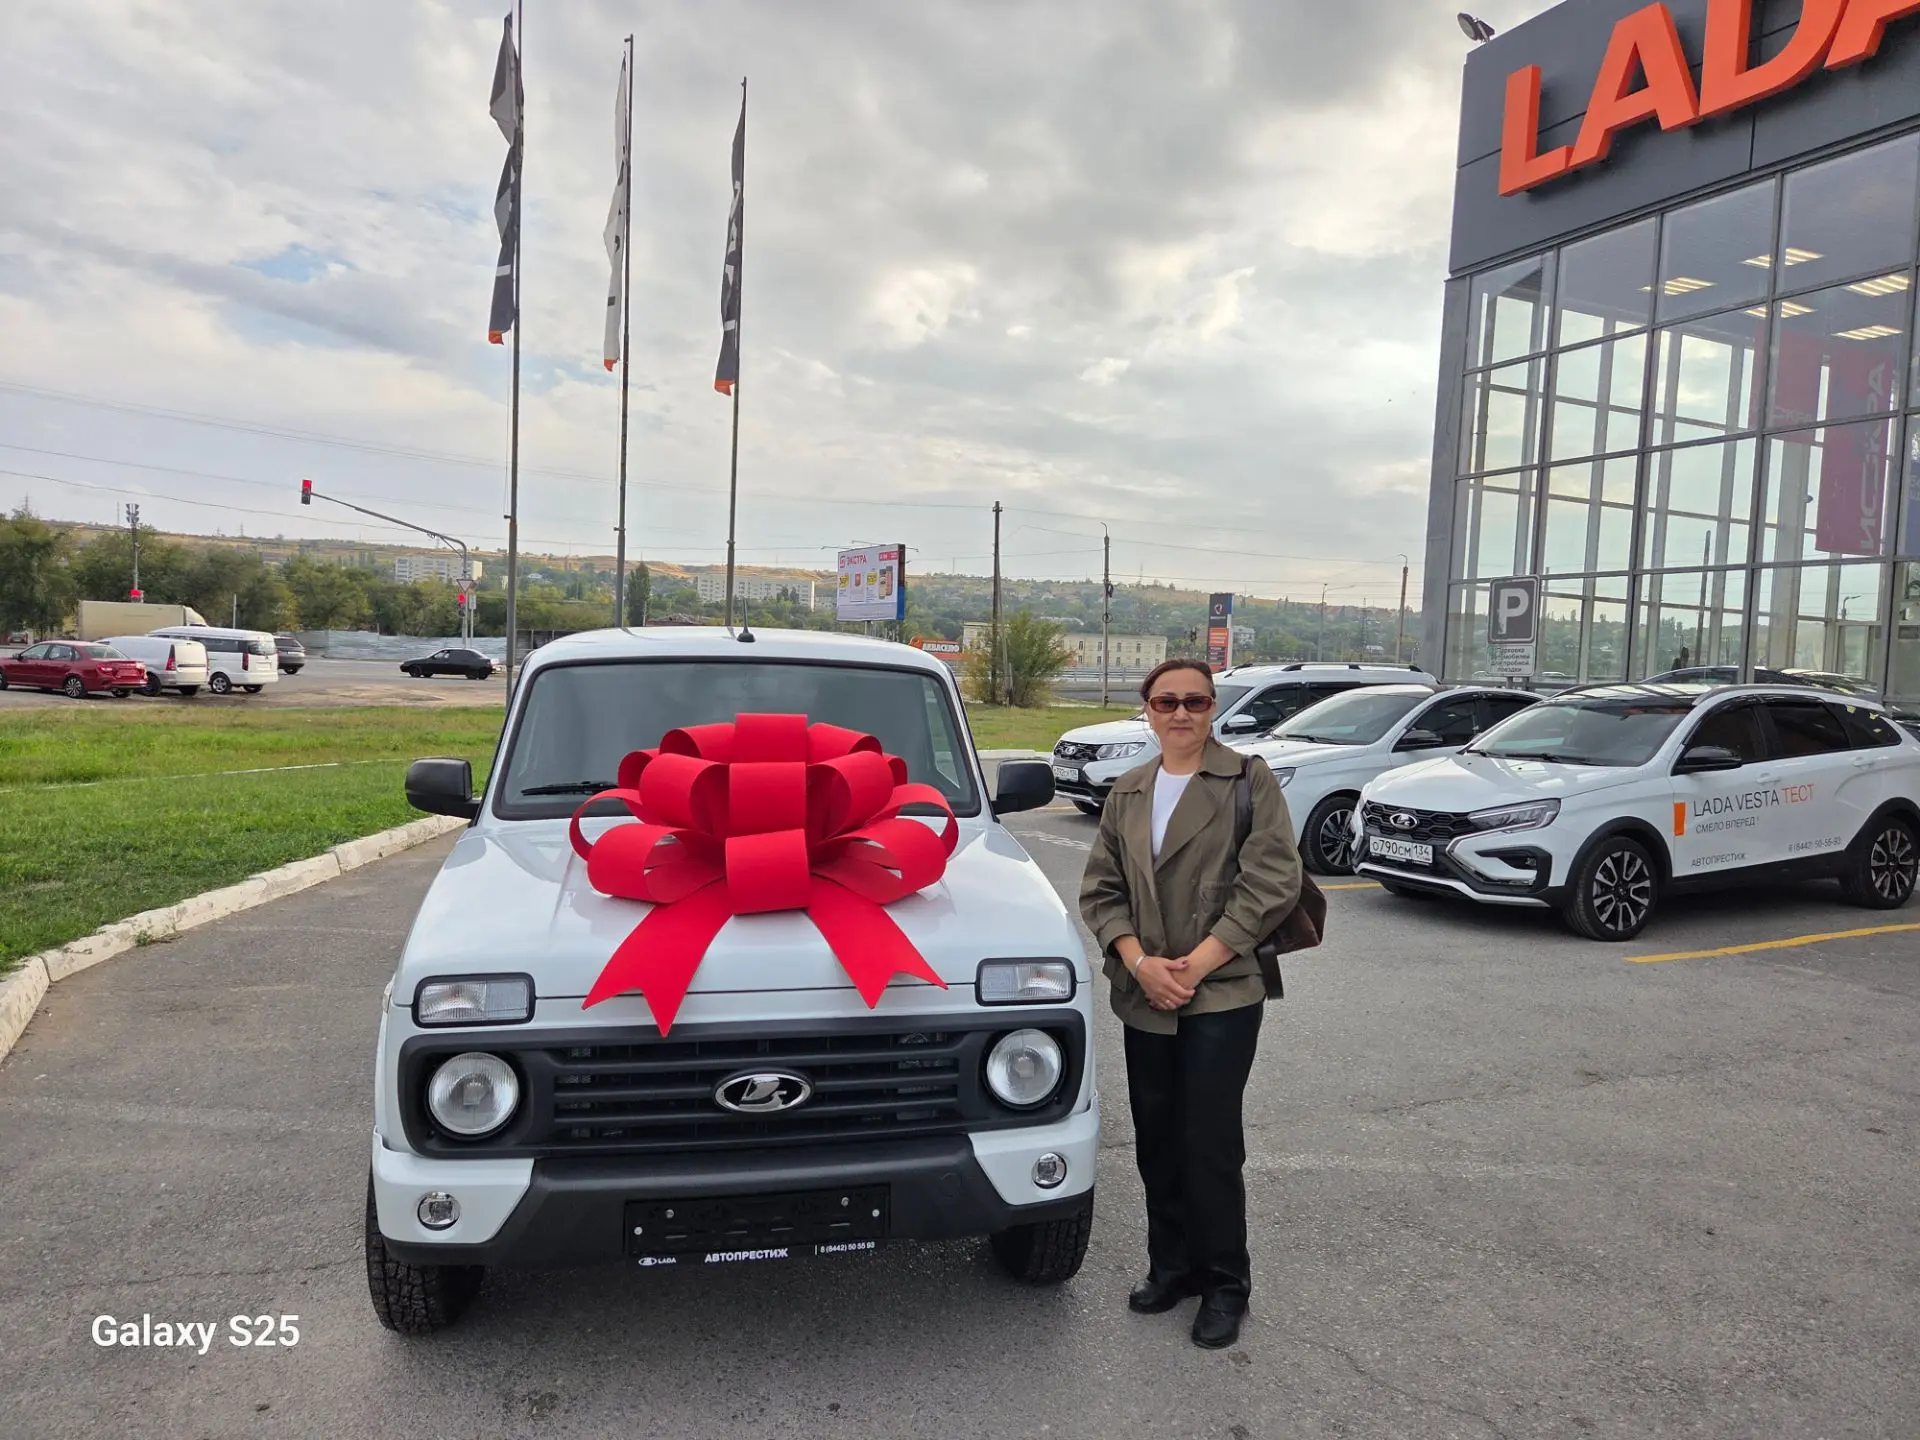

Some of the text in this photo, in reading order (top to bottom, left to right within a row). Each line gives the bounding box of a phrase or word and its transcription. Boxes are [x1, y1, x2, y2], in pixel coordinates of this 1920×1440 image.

[1498, 0, 1920, 197] LAD
[1498, 588, 1529, 634] P
[1693, 783, 1815, 817] LADA VESTA ТЕСТ
[1696, 821, 1724, 834] СМЕЛО
[1414, 844, 1429, 856] 134
[1691, 852, 1746, 867] АВТОПРЕСТИЖ
[705, 1248, 788, 1263] АВТОПРЕСТИЖ
